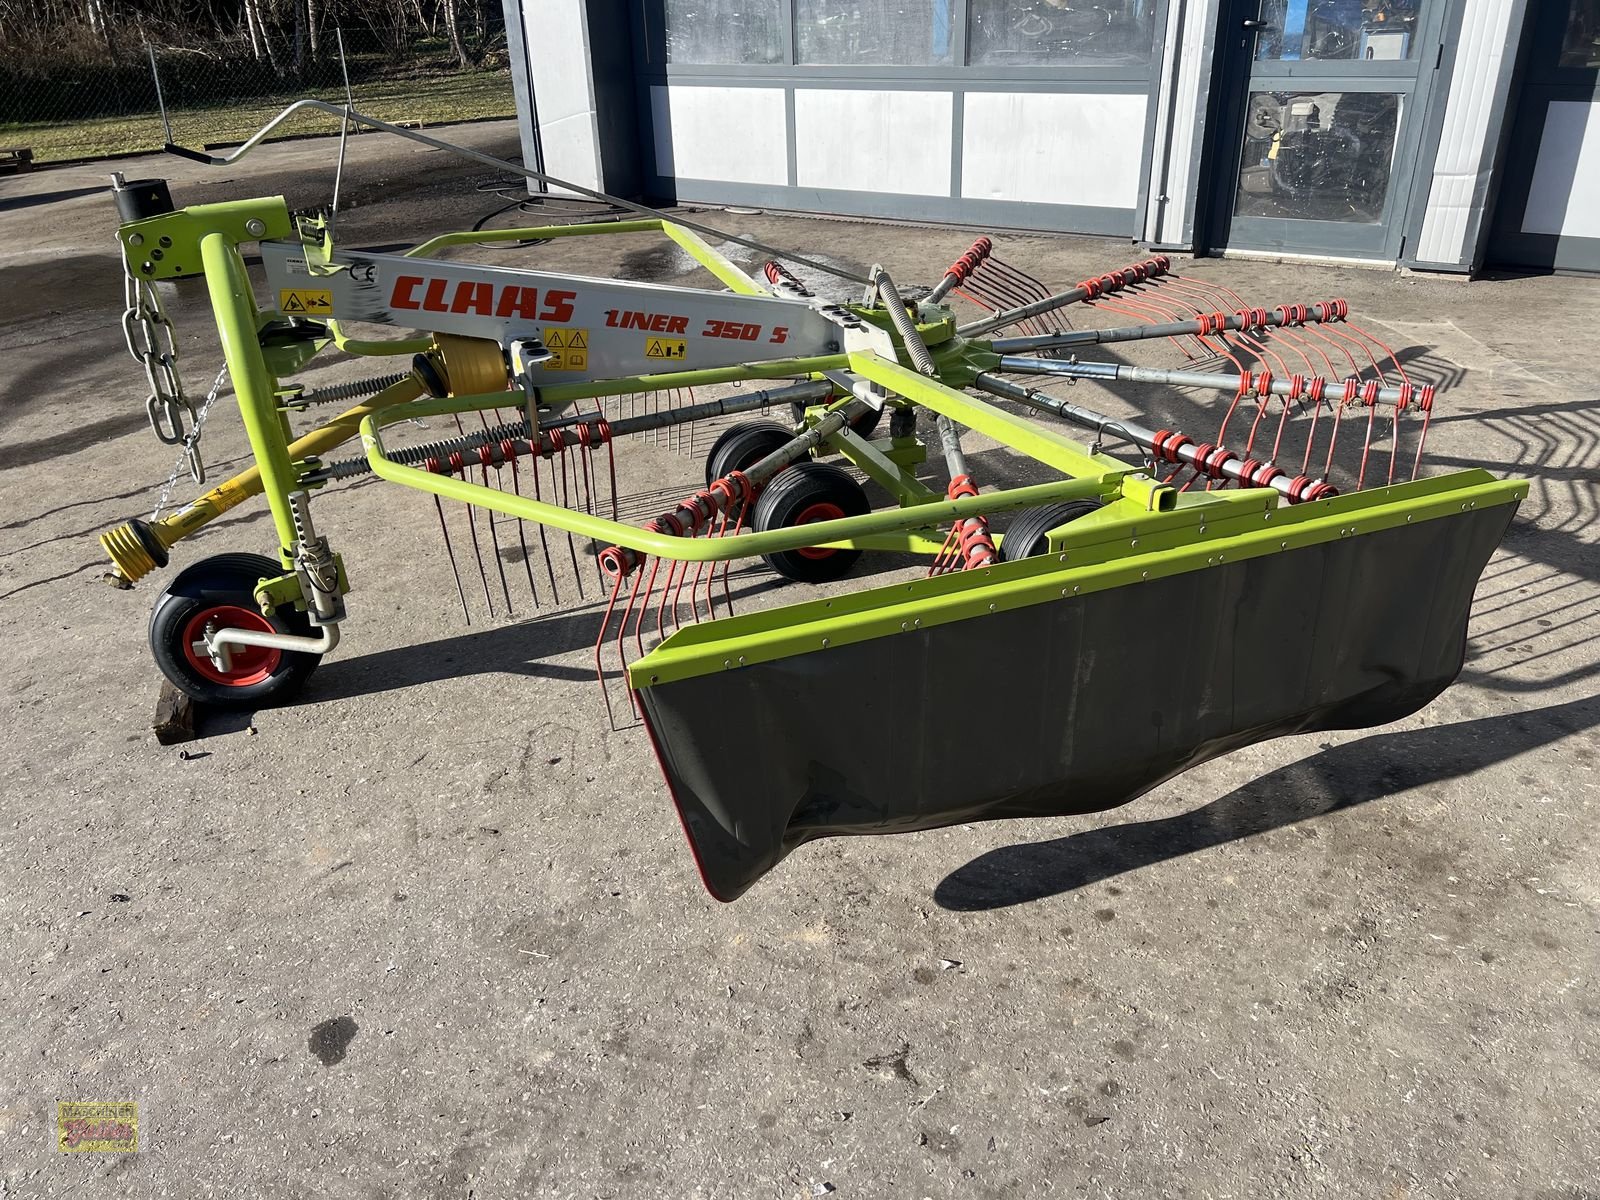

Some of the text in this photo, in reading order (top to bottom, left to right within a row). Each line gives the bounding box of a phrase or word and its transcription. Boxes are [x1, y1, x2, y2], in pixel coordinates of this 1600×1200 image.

[390, 275, 577, 322] CLAAS
[605, 310, 789, 344] LINER 350 S
